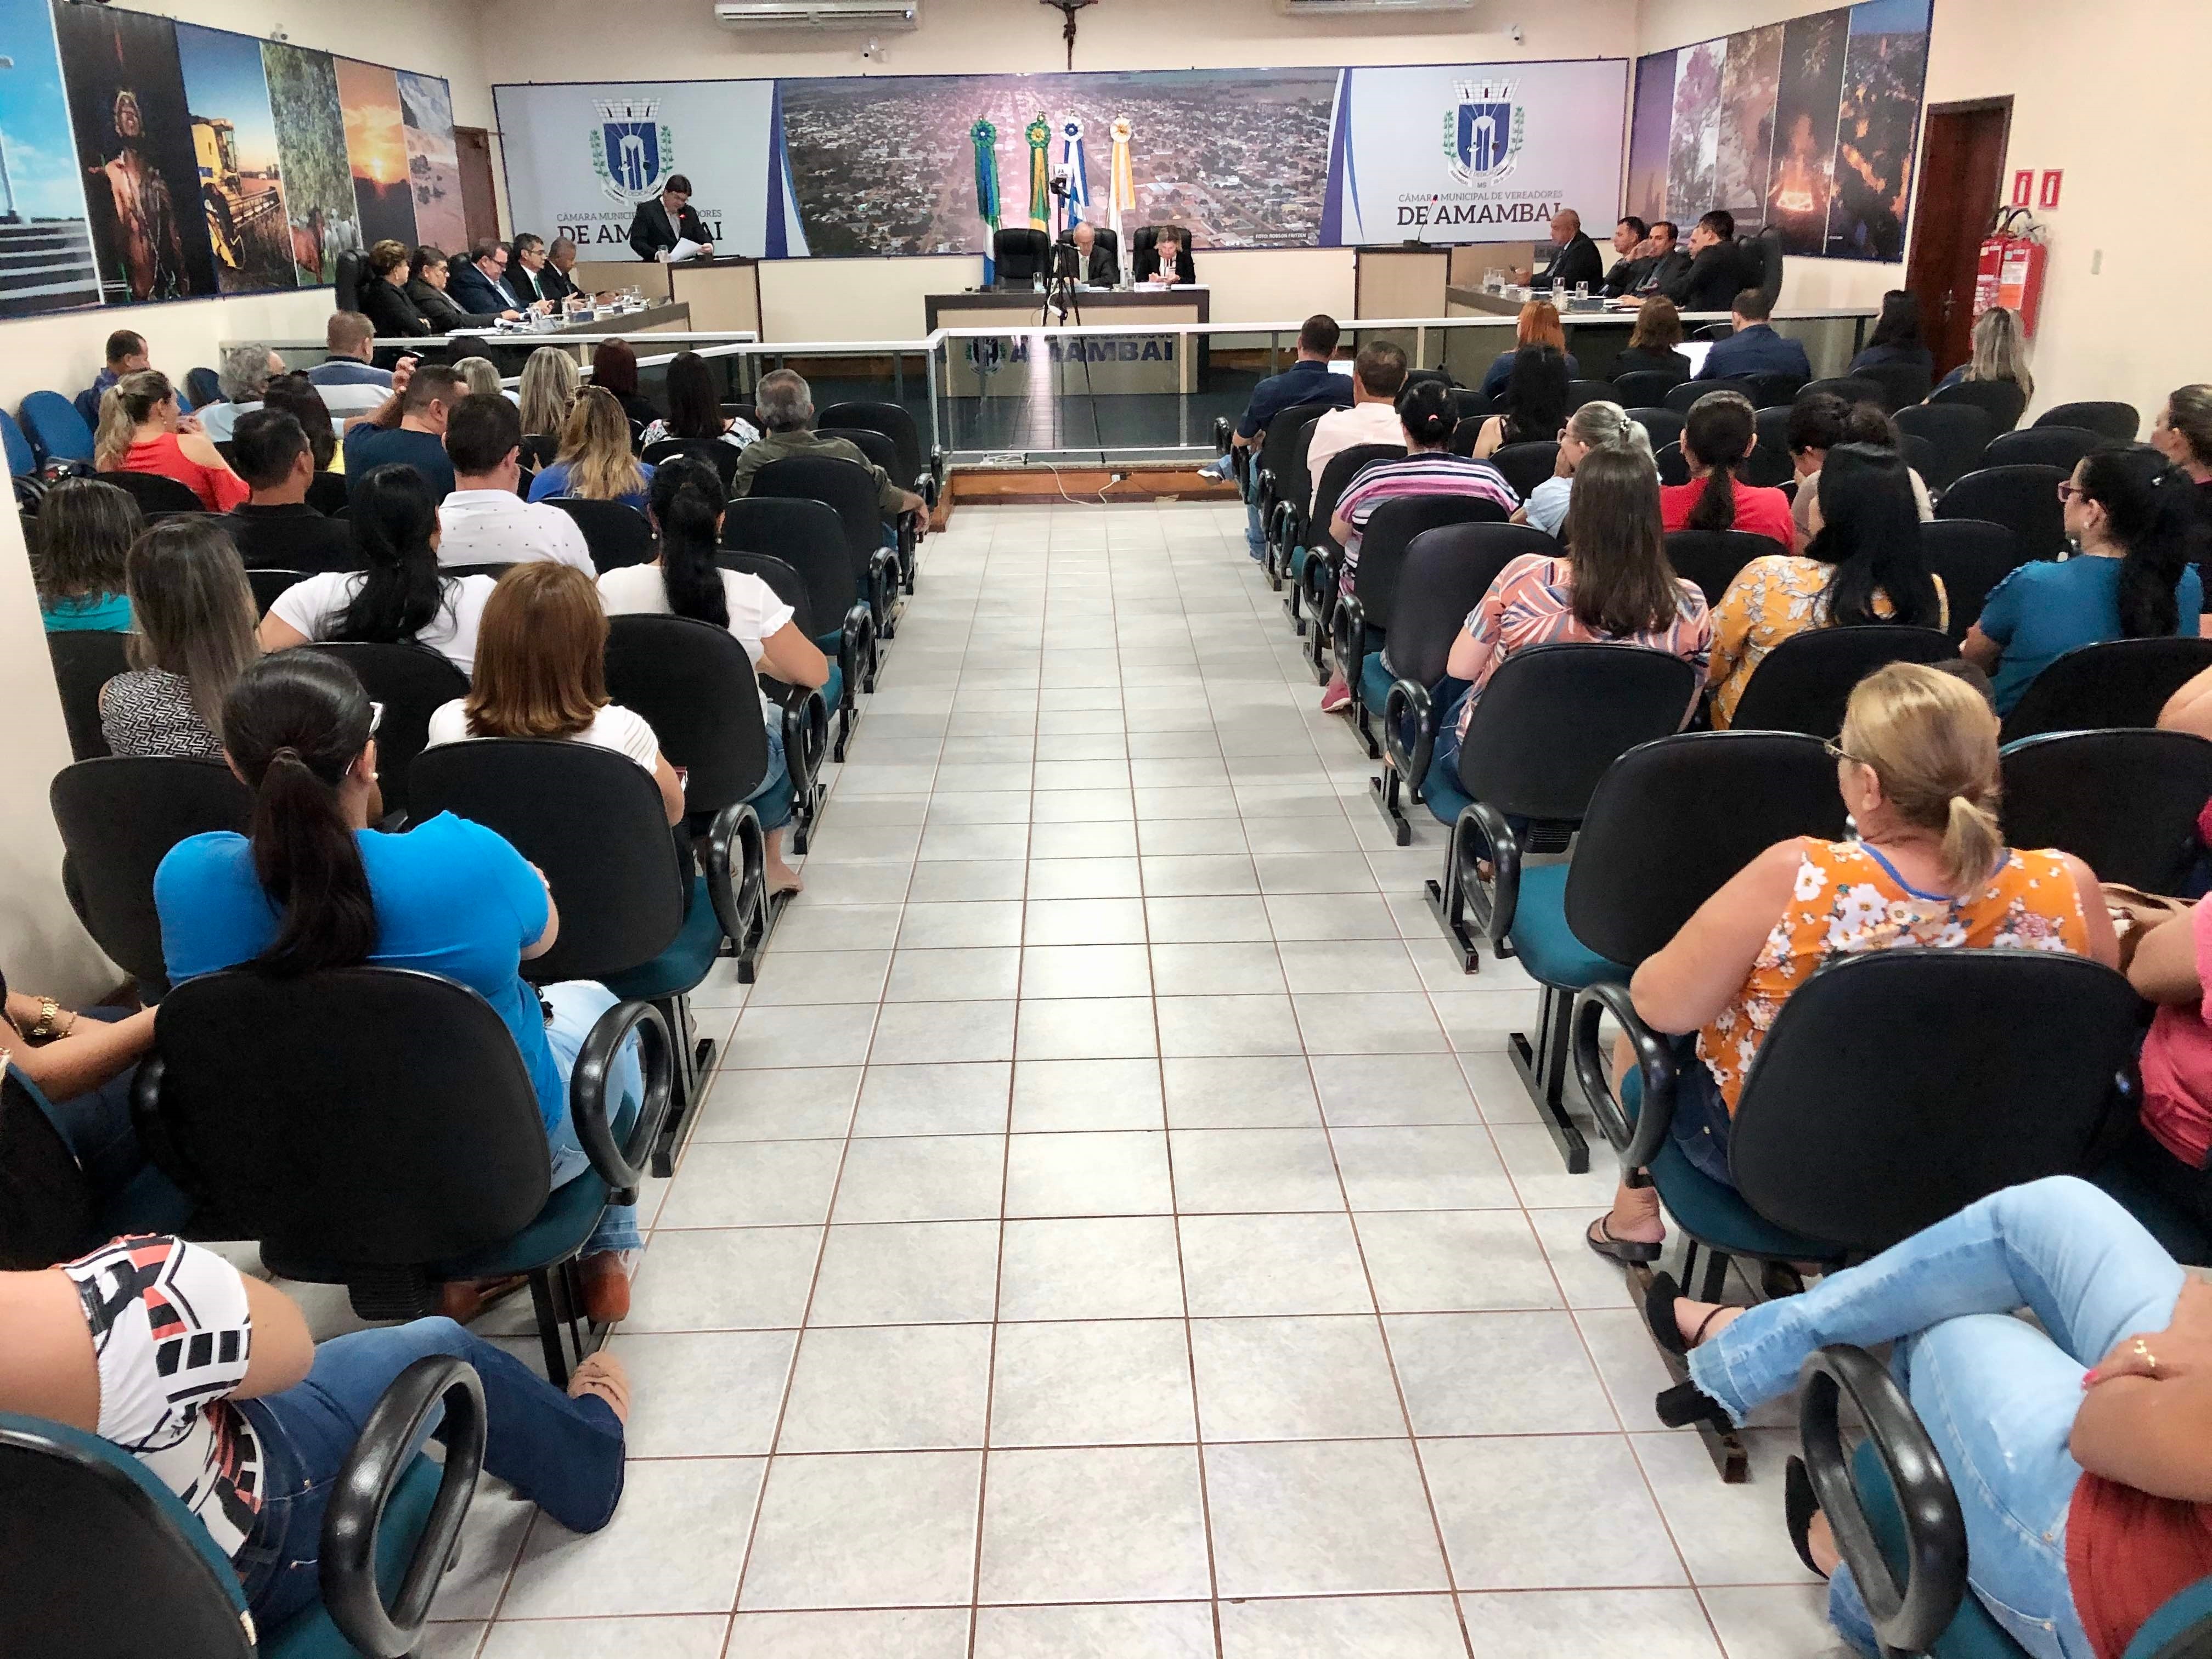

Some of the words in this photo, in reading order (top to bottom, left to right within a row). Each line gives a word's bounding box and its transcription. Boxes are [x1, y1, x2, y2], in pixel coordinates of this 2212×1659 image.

[1398, 193, 1438, 202] CÂMAR
[1441, 191, 1489, 201] MUNICIPAL
[1491, 191, 1503, 200] DE
[1505, 190, 1563, 200] VEREADORES
[556, 212, 597, 222] CÂMARA
[1397, 206, 1429, 225] DE
[557, 224, 590, 244] DE
